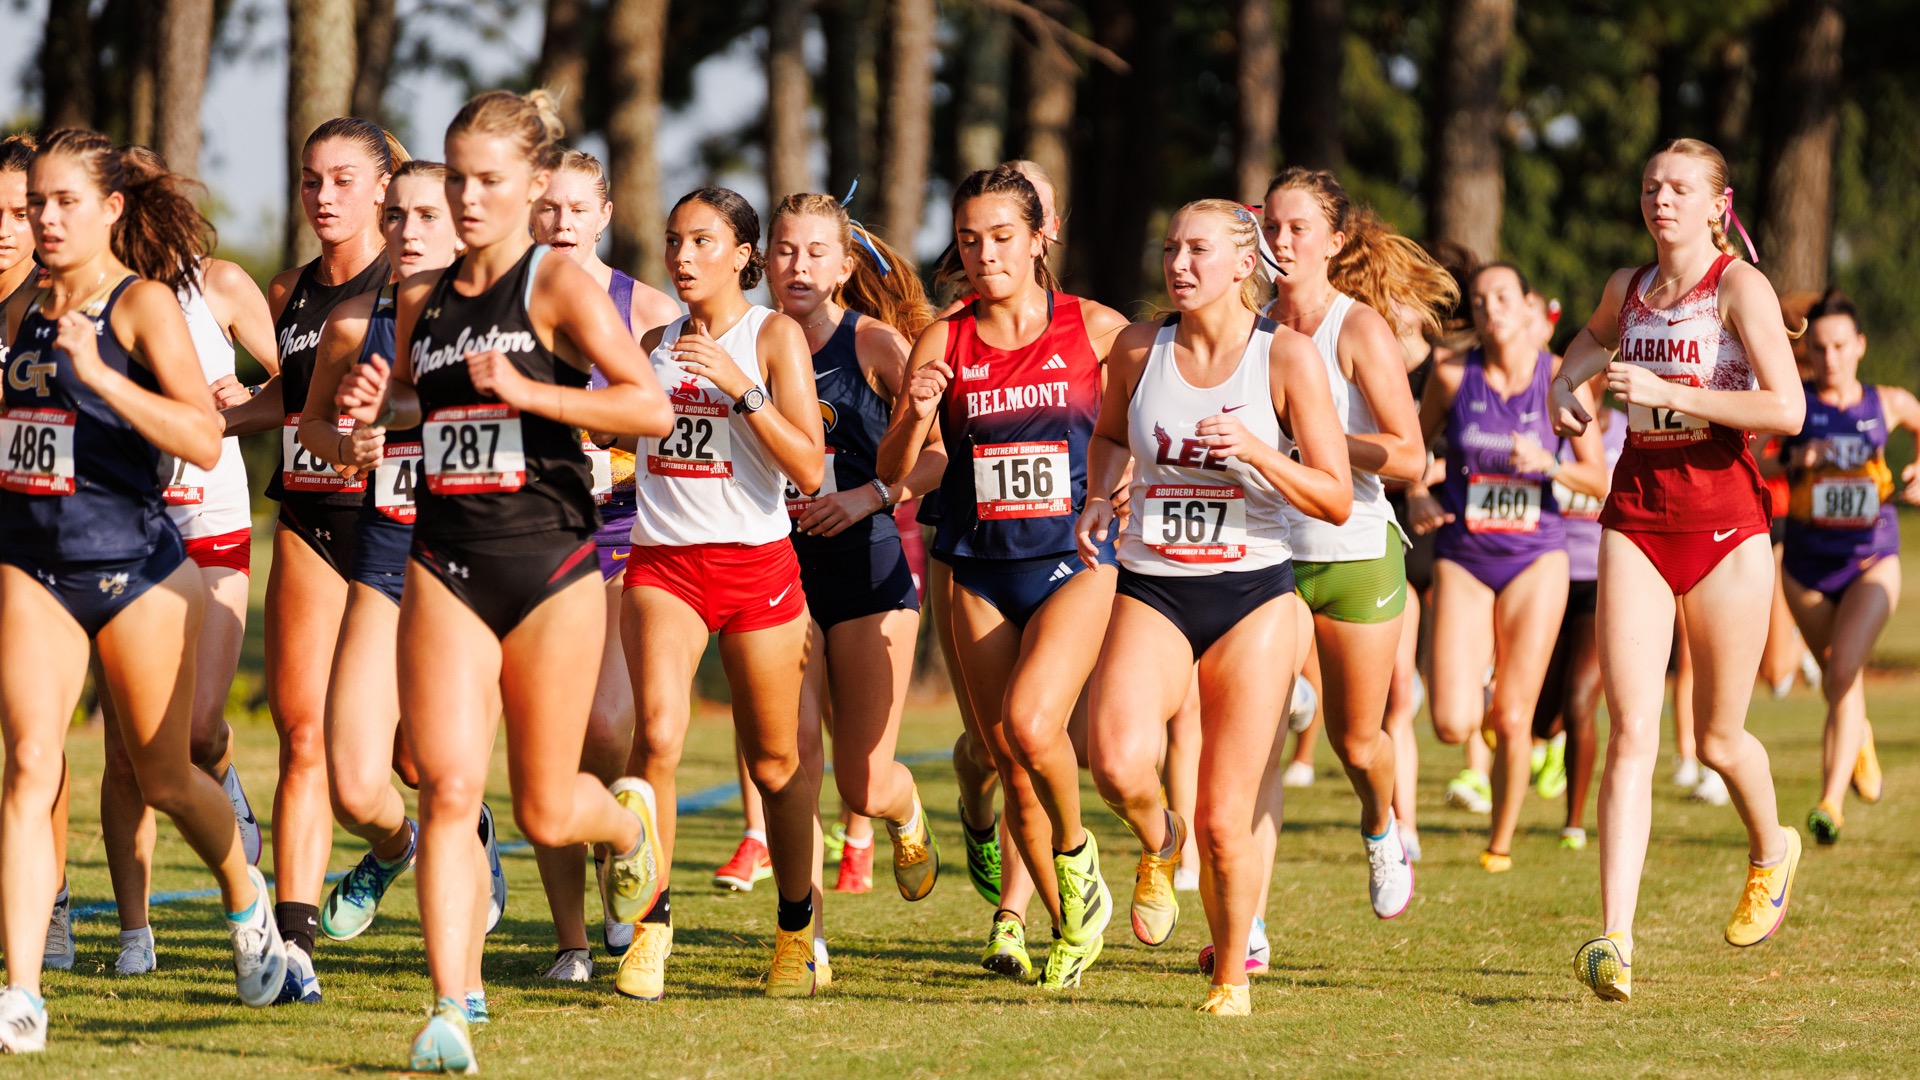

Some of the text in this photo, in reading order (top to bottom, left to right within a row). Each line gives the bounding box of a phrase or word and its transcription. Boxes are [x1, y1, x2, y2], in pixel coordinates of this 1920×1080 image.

[411, 325, 536, 385] Charleston
[1620, 338, 1700, 364] ALABAMA
[8, 350, 57, 397] GT
[684, 405, 719, 415] SHOWCASE
[966, 382, 1069, 419] BELMONT
[8, 425, 56, 473] 486
[440, 424, 500, 471] 287
[658, 417, 713, 459] 232
[984, 445, 1059, 456] SOUTHERN SHOWCASE
[1152, 421, 1228, 472] LEE
[294, 476, 321, 484] SEPTEMBER
[660, 462, 687, 470] SEPTEMBER
[992, 457, 1053, 499] 156
[995, 503, 1025, 512] SEPTEMBER
[1049, 504, 1067, 512] STATE
[1155, 488, 1235, 497] SOUTHERN SHOWCASE
[1482, 487, 1528, 519] 460
[1825, 486, 1867, 517] 987
[1162, 501, 1227, 543] 567
